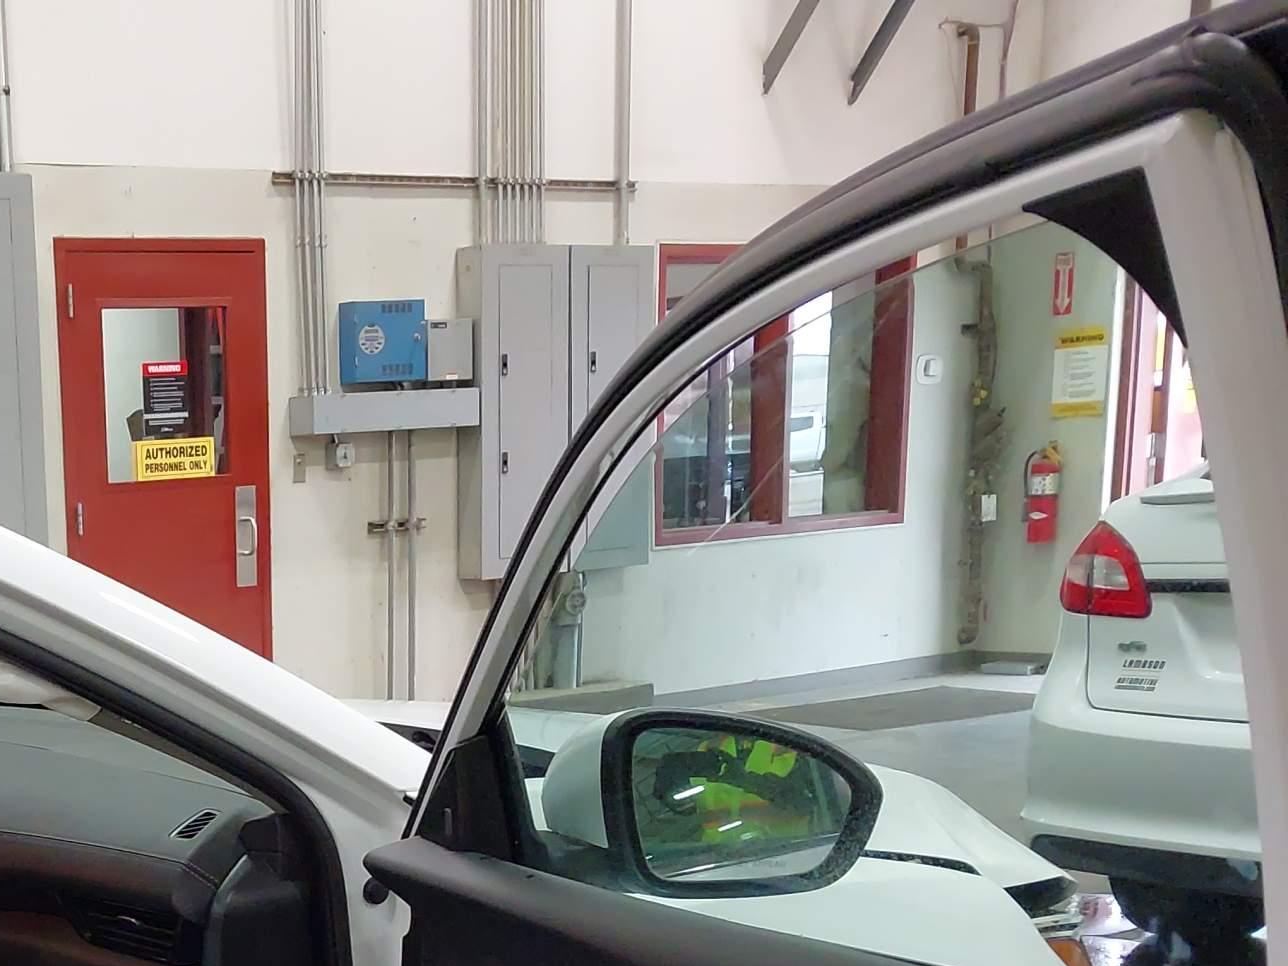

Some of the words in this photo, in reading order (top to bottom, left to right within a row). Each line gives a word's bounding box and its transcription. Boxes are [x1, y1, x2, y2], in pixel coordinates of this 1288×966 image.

[147, 363, 182, 373] WARNING
[145, 445, 208, 460] AUTHORIZED
[145, 462, 186, 473] PERSONNEL
[189, 460, 208, 470] ONLY
